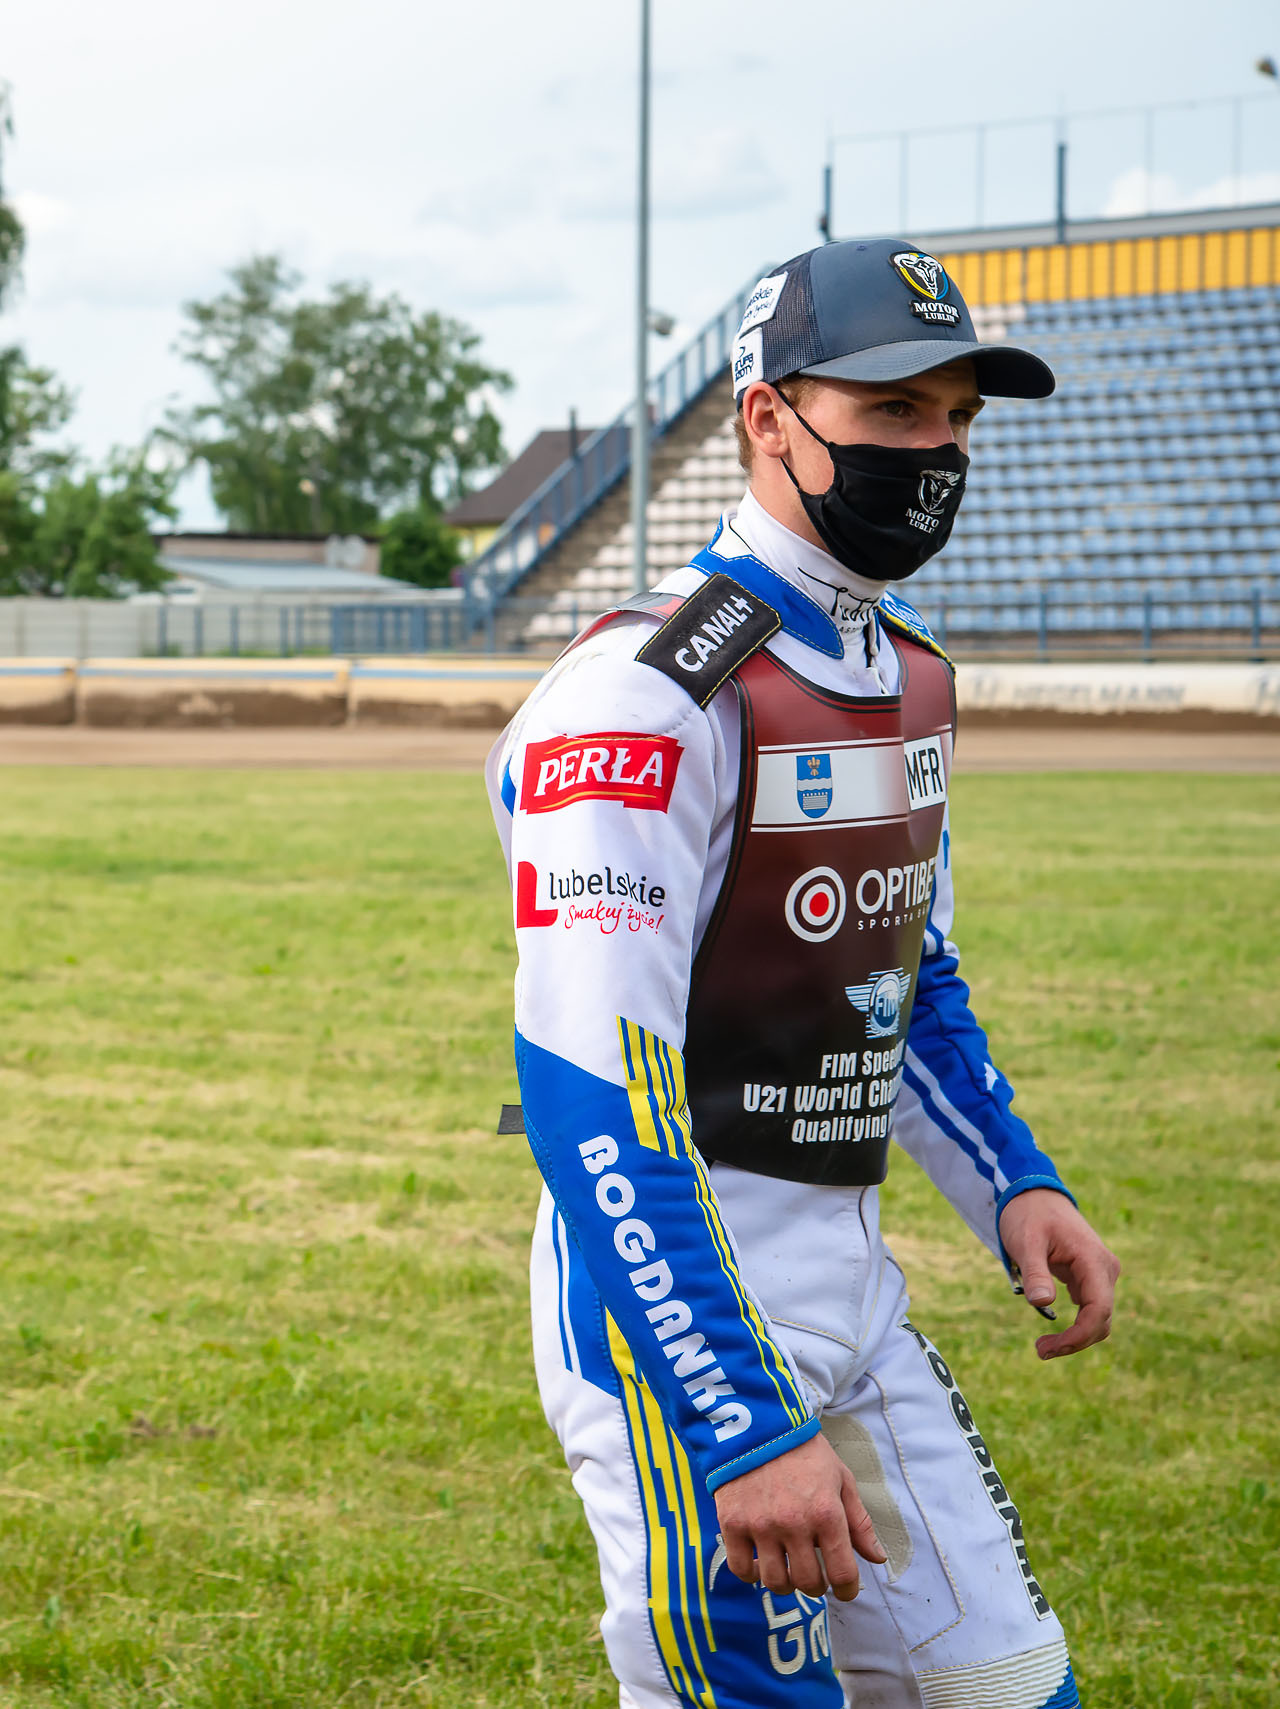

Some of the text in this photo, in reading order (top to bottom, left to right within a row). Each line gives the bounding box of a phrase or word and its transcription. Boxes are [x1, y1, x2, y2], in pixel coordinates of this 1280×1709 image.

[914, 302, 959, 318] MOTOR
[924, 312, 955, 322] LUBLIN
[909, 519, 935, 534] LUBLI
[675, 594, 753, 673] CANAL+
[533, 744, 664, 798] PERŁA
[905, 747, 943, 800] MFR
[627, 904, 665, 935] życie!
[857, 912, 914, 931] SPORTA
[820, 1052, 857, 1079] FIM
[743, 1084, 787, 1113] U21
[794, 1081, 863, 1113] World
[791, 1113, 888, 1144] Qualifying
[578, 1134, 753, 1443] BOGDANKA
